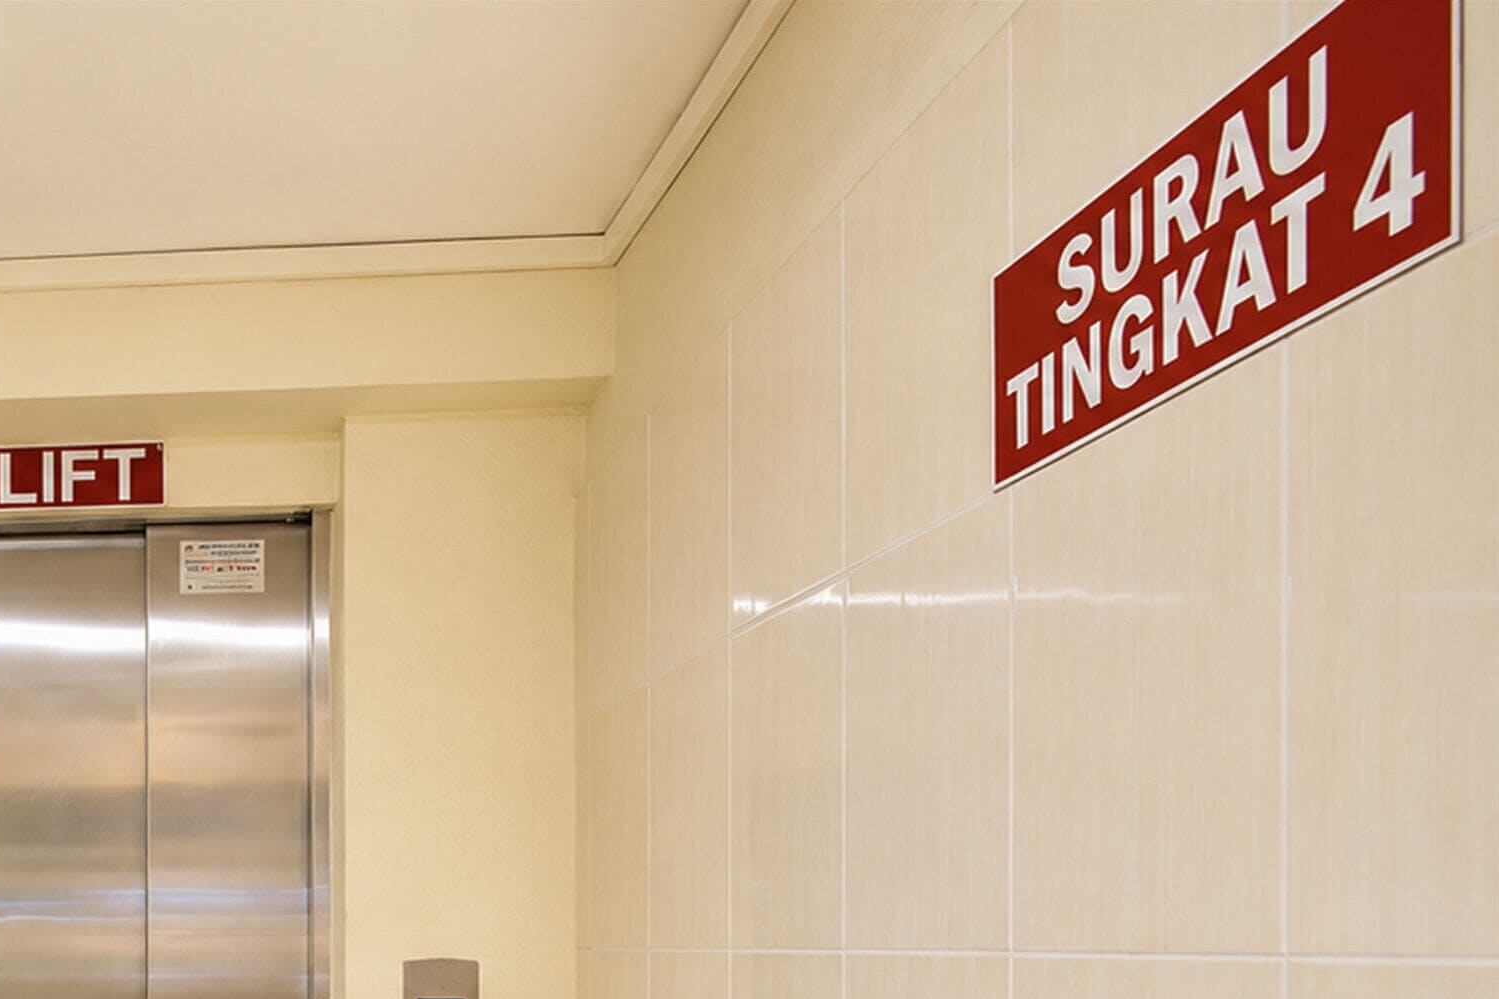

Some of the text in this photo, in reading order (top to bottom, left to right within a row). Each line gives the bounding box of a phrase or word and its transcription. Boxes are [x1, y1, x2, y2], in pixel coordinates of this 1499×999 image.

[1006, 110, 1426, 450] TINGKAT 4
[1055, 44, 1328, 326] SURAU
[0, 447, 147, 505] LIFT
